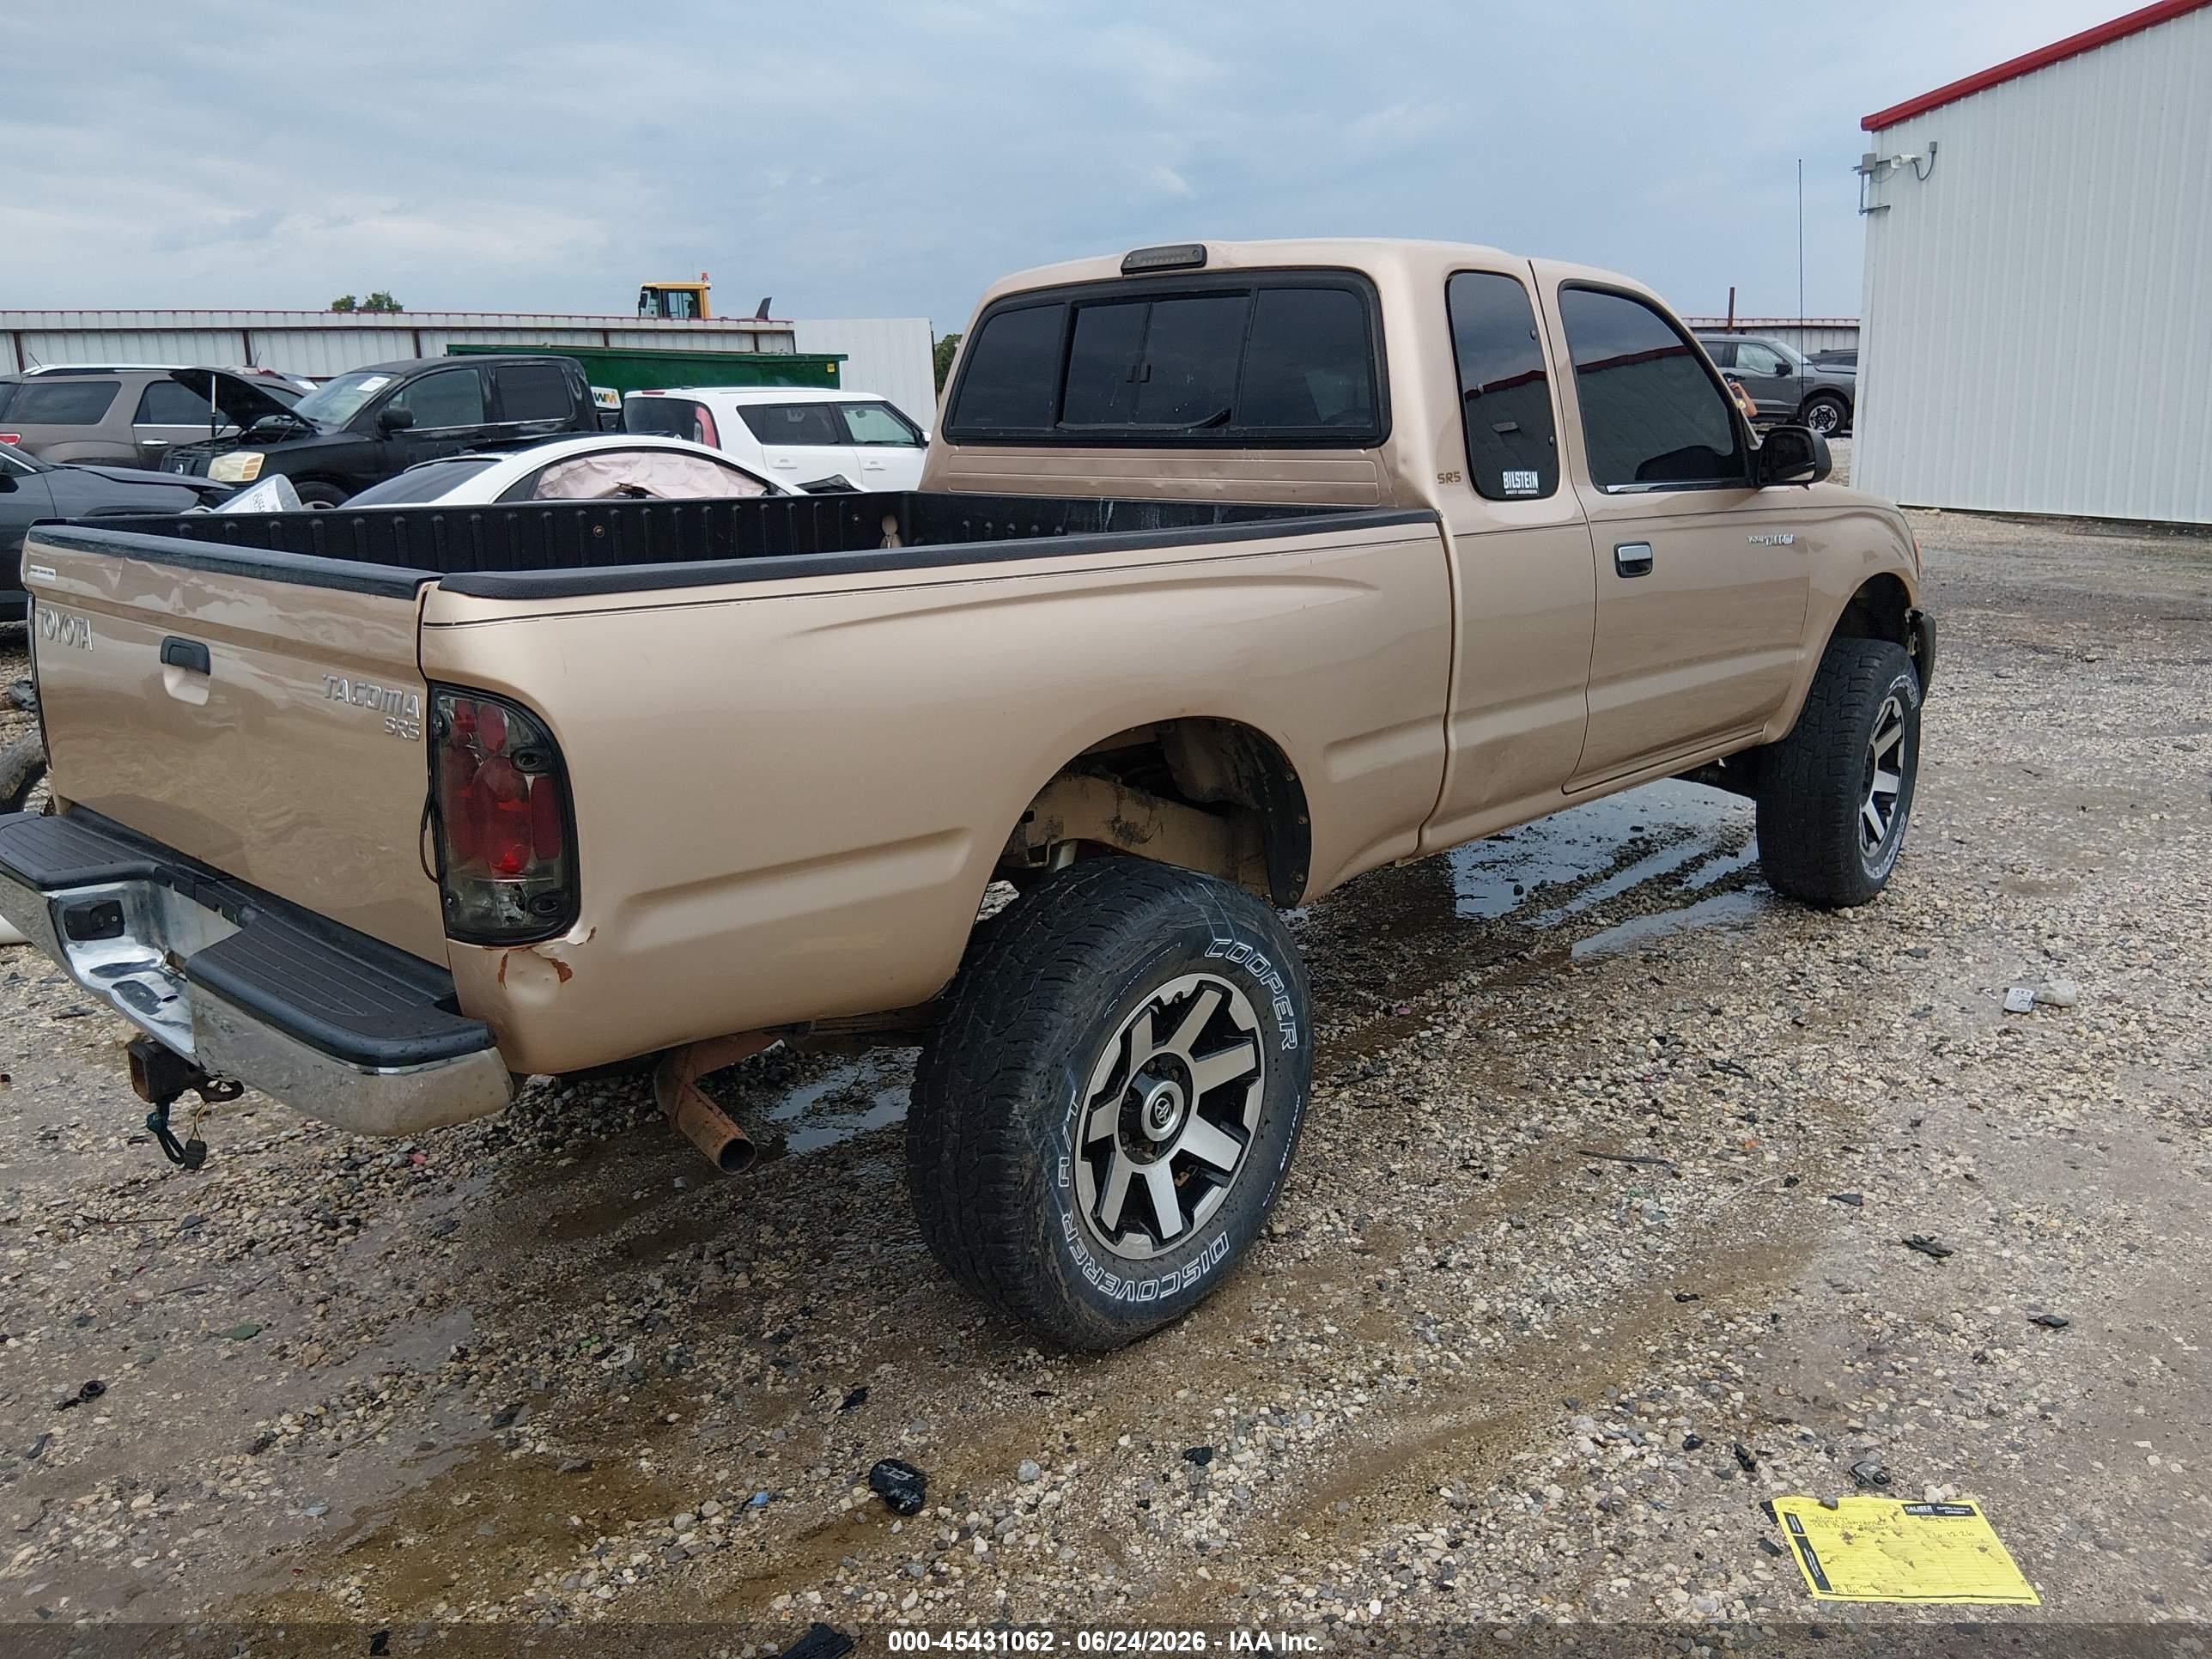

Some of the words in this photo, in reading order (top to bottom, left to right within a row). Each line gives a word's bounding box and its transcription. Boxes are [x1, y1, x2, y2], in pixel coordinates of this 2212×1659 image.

[593, 392, 617, 404] WM
[1437, 471, 1462, 484] SR5
[1502, 471, 1539, 489] BILSTEIN
[36, 607, 94, 653] TOYOTA
[322, 673, 420, 720] TACOMA
[384, 716, 420, 742] SR5
[1204, 938, 1299, 1052] COOPER
[1061, 1209, 1231, 1303] DISCOVERER
